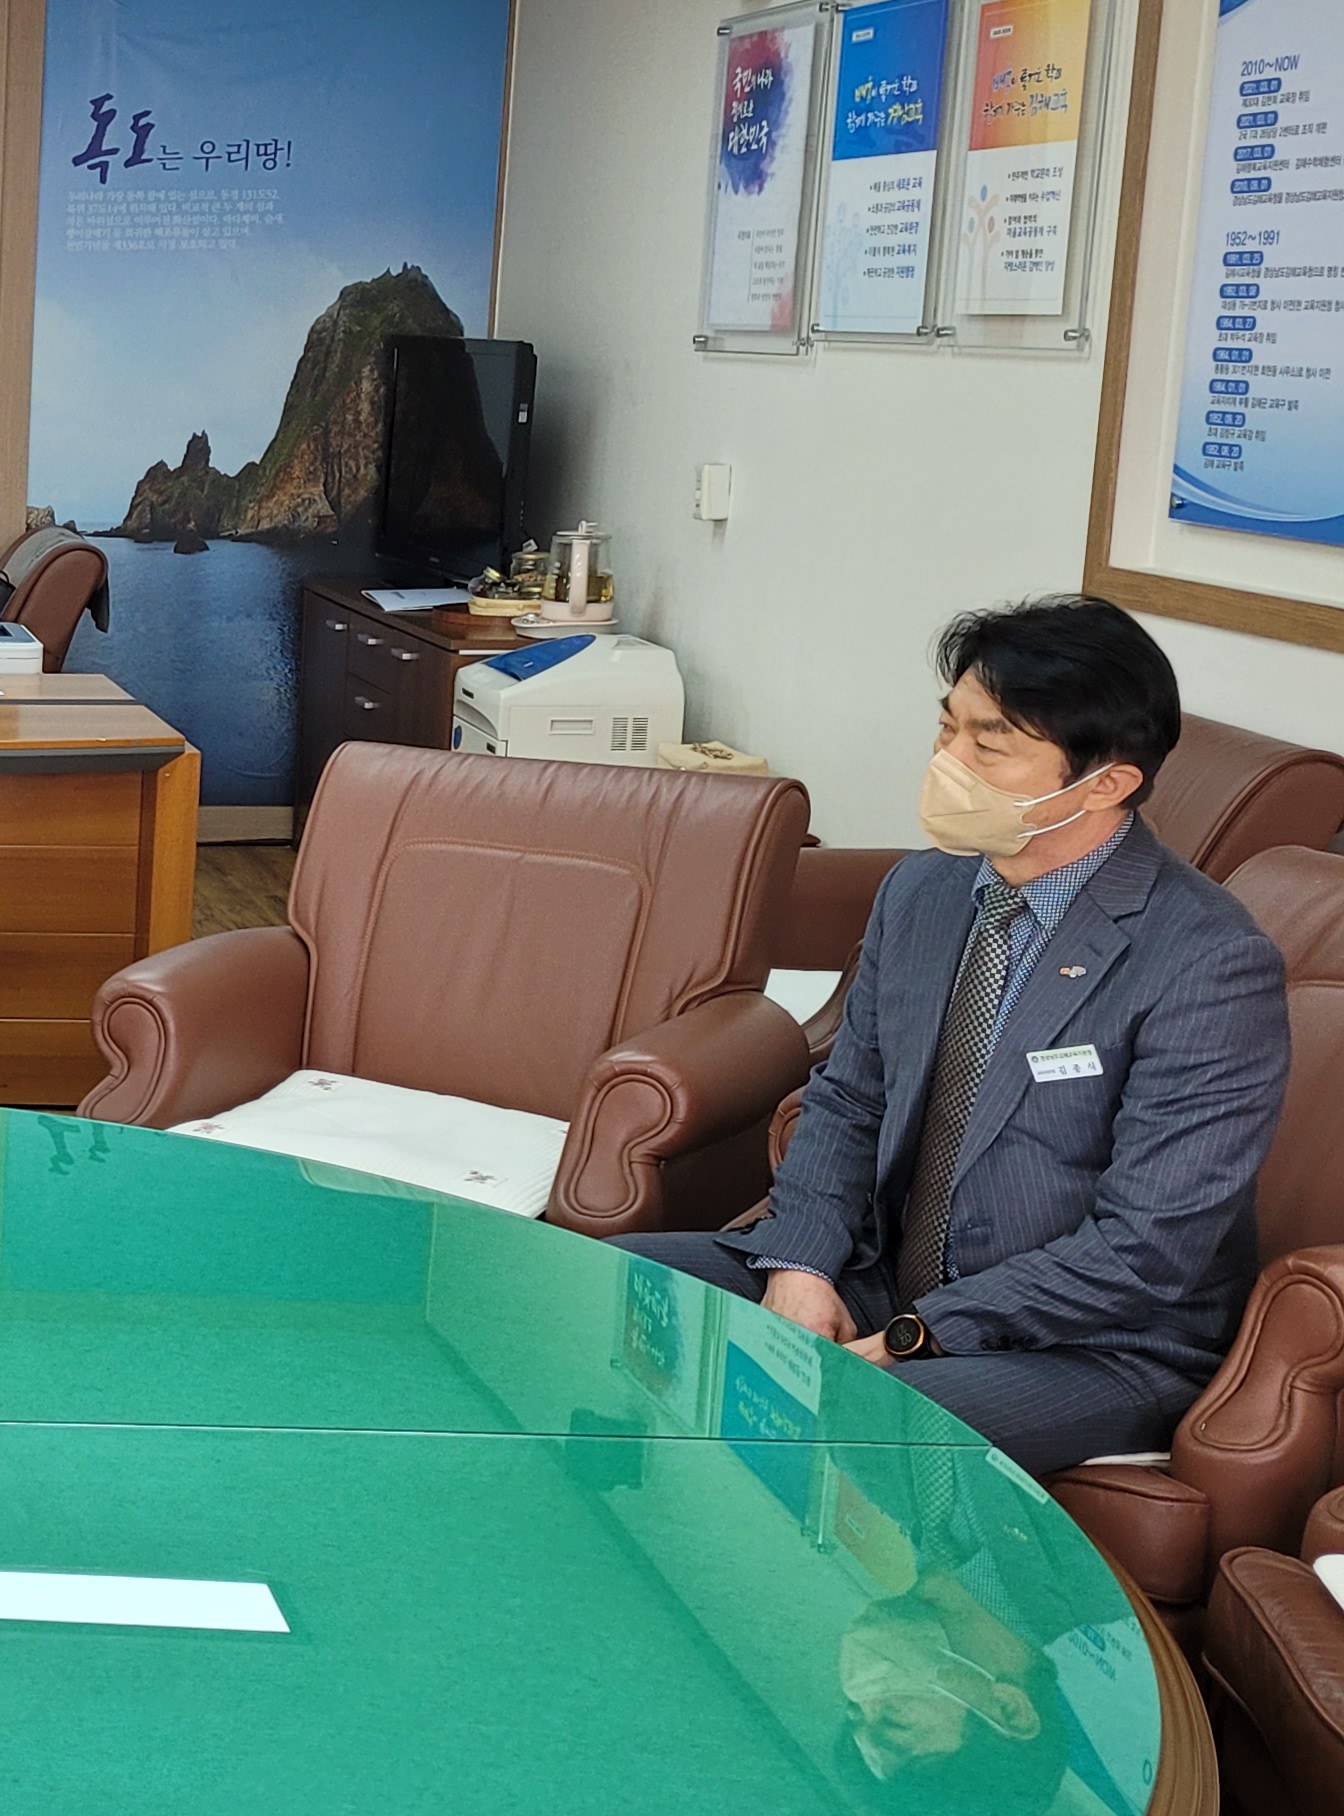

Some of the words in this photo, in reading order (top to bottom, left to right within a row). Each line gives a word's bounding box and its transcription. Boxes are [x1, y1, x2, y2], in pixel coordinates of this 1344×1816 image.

[1241, 54, 1300, 76] 2010~NOW
[71, 93, 184, 184] 독도는
[192, 139, 293, 171] 우리땅!
[728, 120, 769, 155] 대한민국
[1226, 230, 1280, 246] 1952~1991
